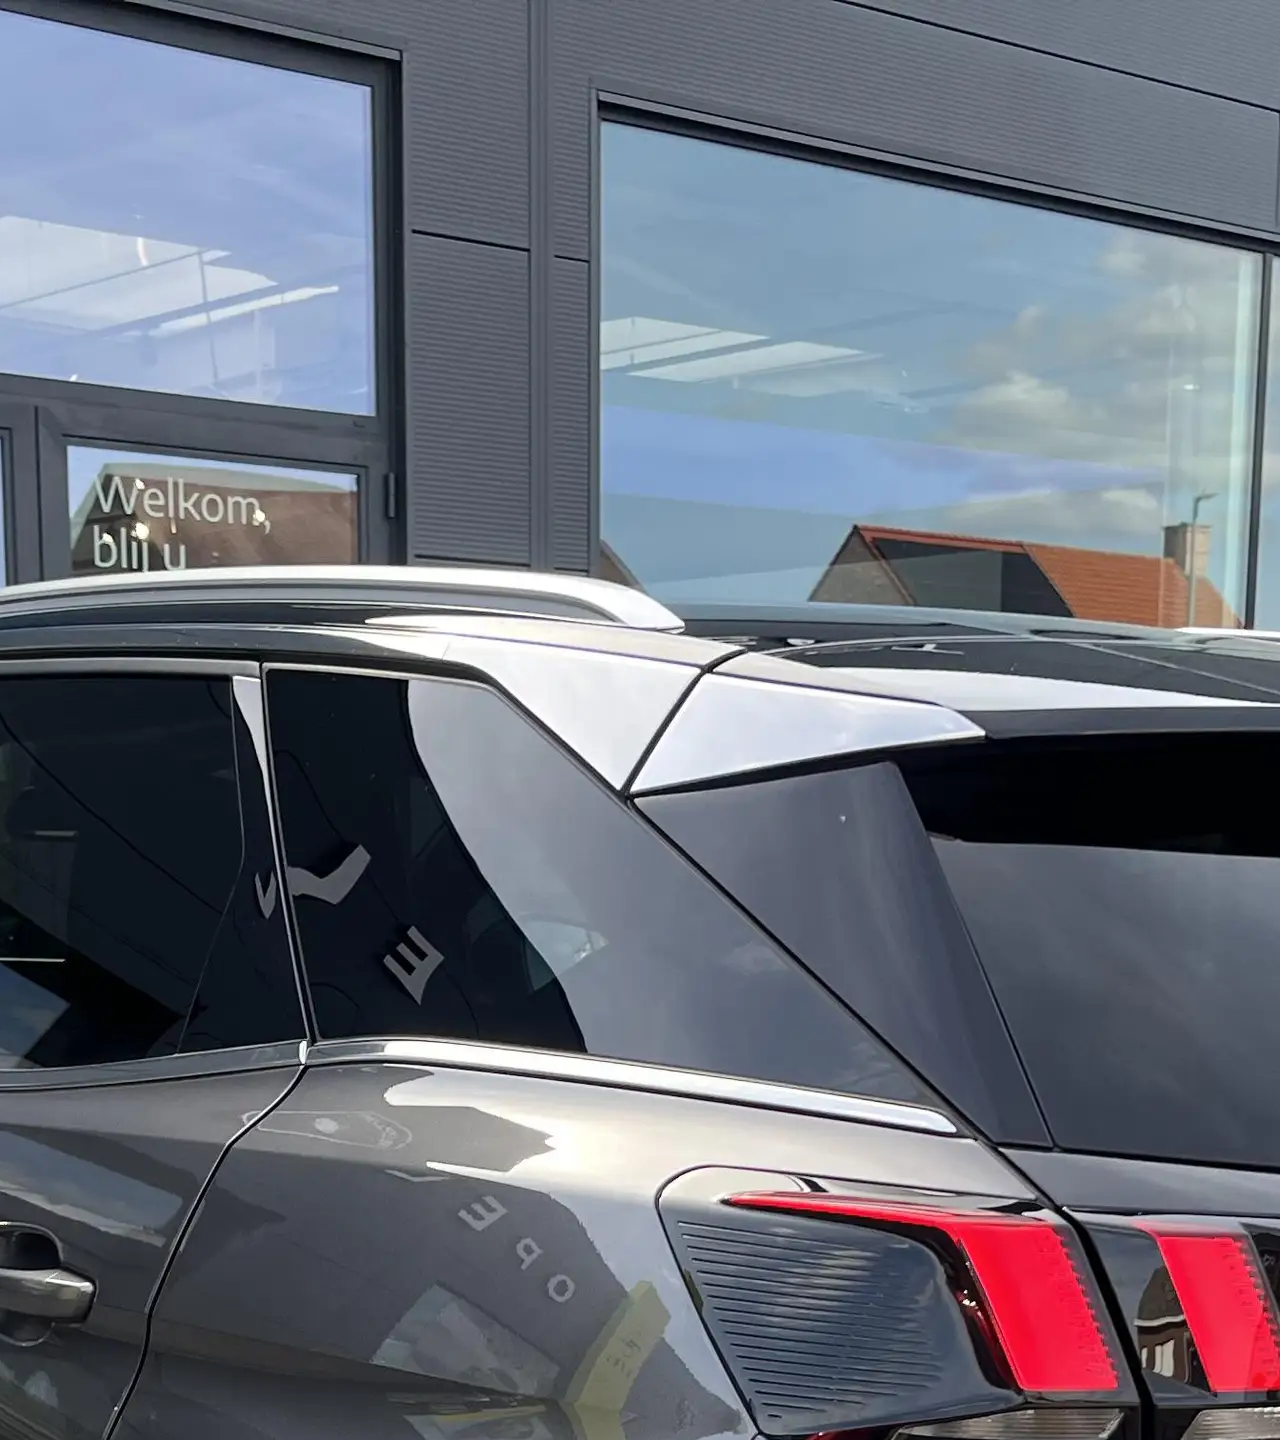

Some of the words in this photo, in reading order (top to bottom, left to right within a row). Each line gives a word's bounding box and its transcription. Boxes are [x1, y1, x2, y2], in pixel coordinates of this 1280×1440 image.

[93, 475, 271, 535] Welkom,
[92, 524, 150, 572] blij
[163, 543, 186, 571] u
